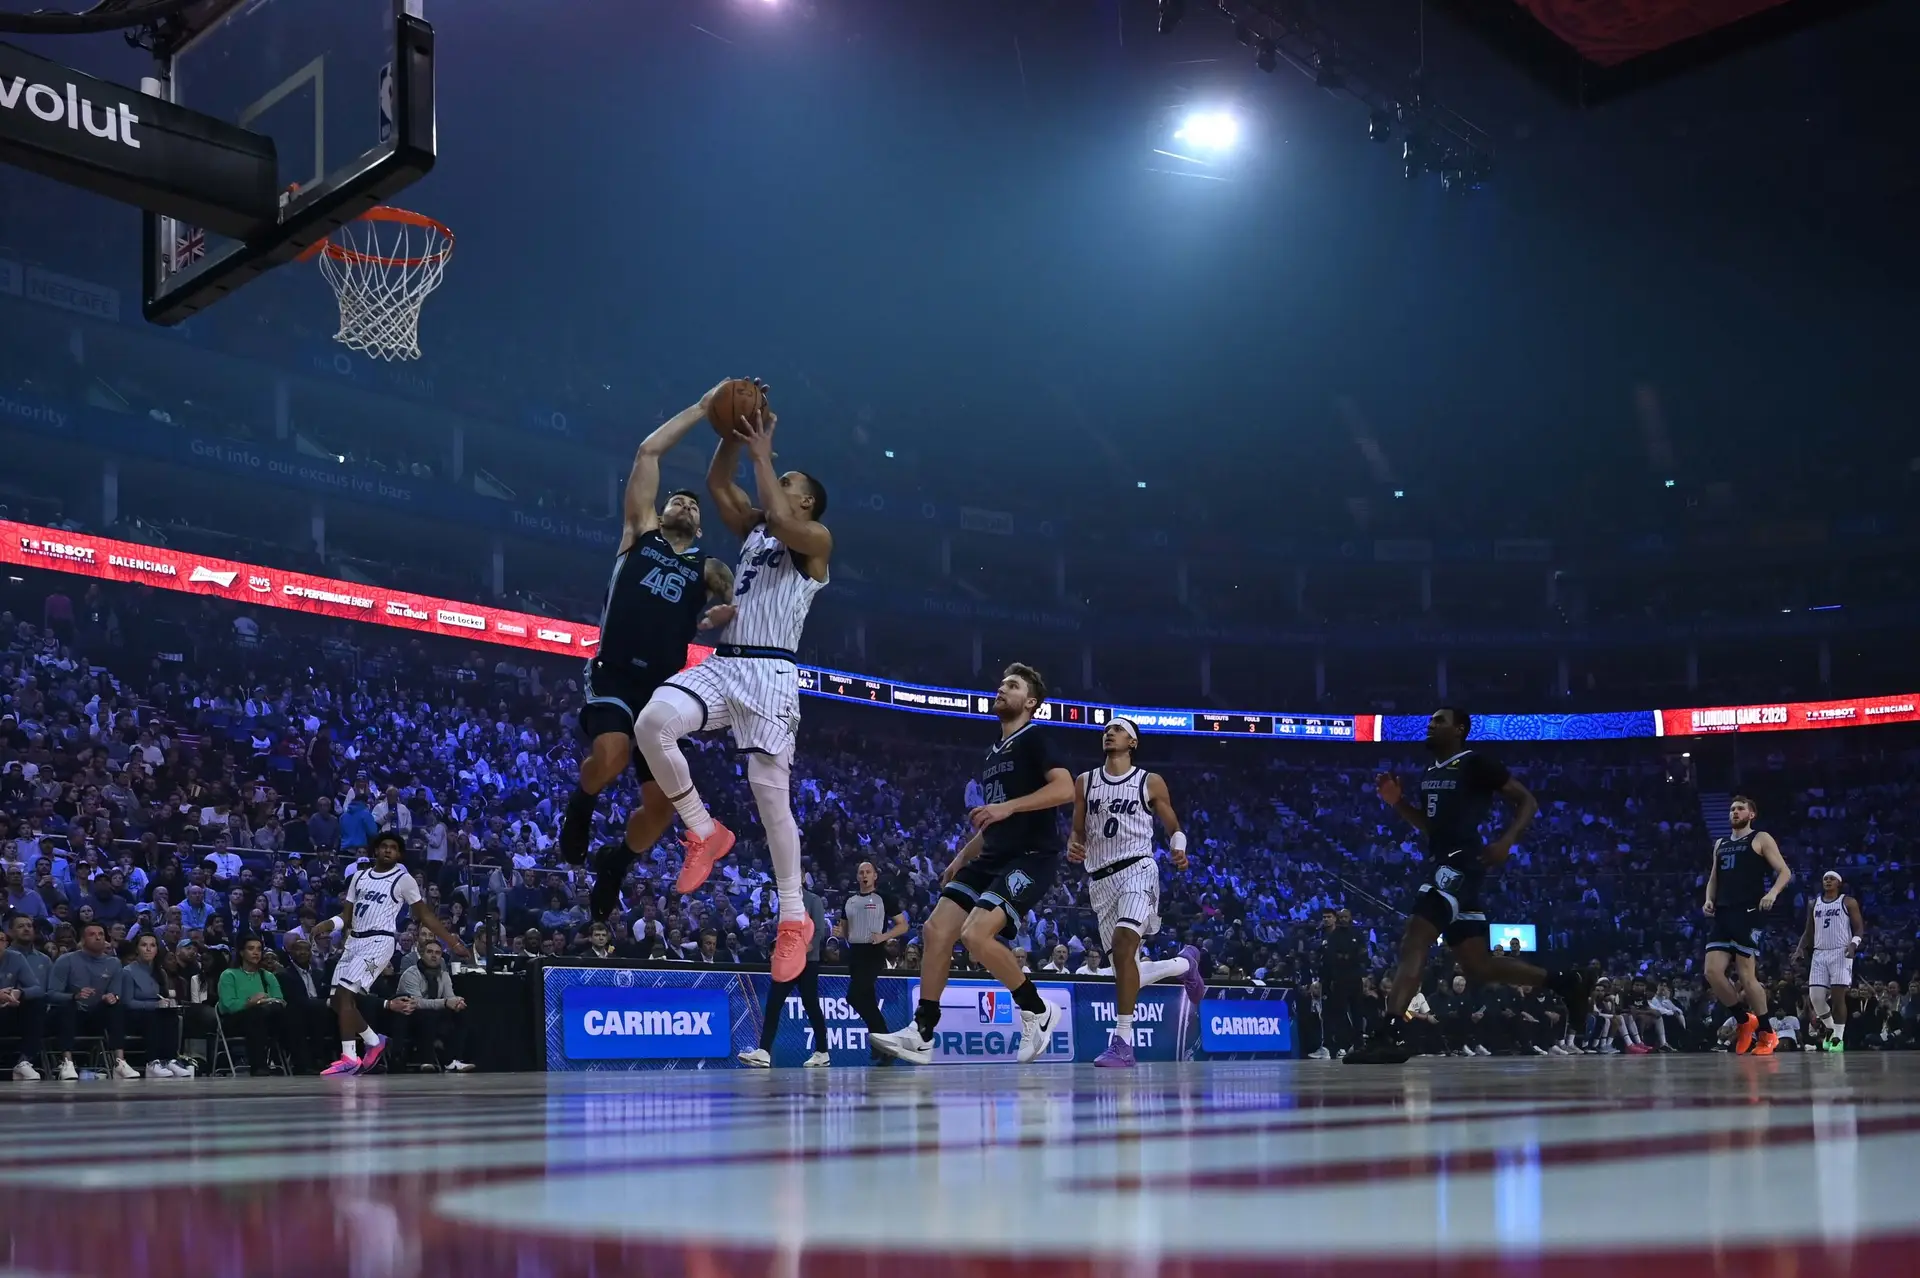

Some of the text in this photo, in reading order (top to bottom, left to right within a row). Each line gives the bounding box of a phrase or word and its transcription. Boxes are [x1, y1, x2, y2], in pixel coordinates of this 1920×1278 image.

[0, 76, 140, 148] volut
[190, 438, 223, 462] Get
[227, 447, 261, 469] into
[267, 459, 294, 476] our
[378, 479, 412, 501] bars
[511, 510, 538, 528] The
[42, 541, 95, 559] TISSOT
[109, 555, 176, 575] BALENCIAGA
[249, 575, 270, 587] aws
[640, 566, 686, 604] 46
[386, 603, 403, 616] abu
[458, 616, 483, 627] Locker
[838, 685, 844, 695] 4
[870, 690, 877, 700] 2
[1701, 710, 1736, 726] LONDON
[1737, 708, 1761, 724] GAME
[1762, 706, 1788, 723] 2026
[1819, 708, 1855, 717] TISSOT
[1865, 704, 1914, 715] BALENCIAGA
[1213, 722, 1219, 731] 5
[1249, 724, 1255, 732] 3
[1427, 793, 1438, 818] 5
[1103, 817, 1119, 838] 0
[1721, 854, 1735, 870] 31
[1824, 918, 1831, 929] 5
[785, 996, 884, 1020] THRSD
[1091, 1002, 1164, 1022] THUSDAY
[804, 1027, 869, 1050] 7M ET
[932, 1031, 1069, 1056] REGAE
[1137, 1028, 1154, 1047] ET
